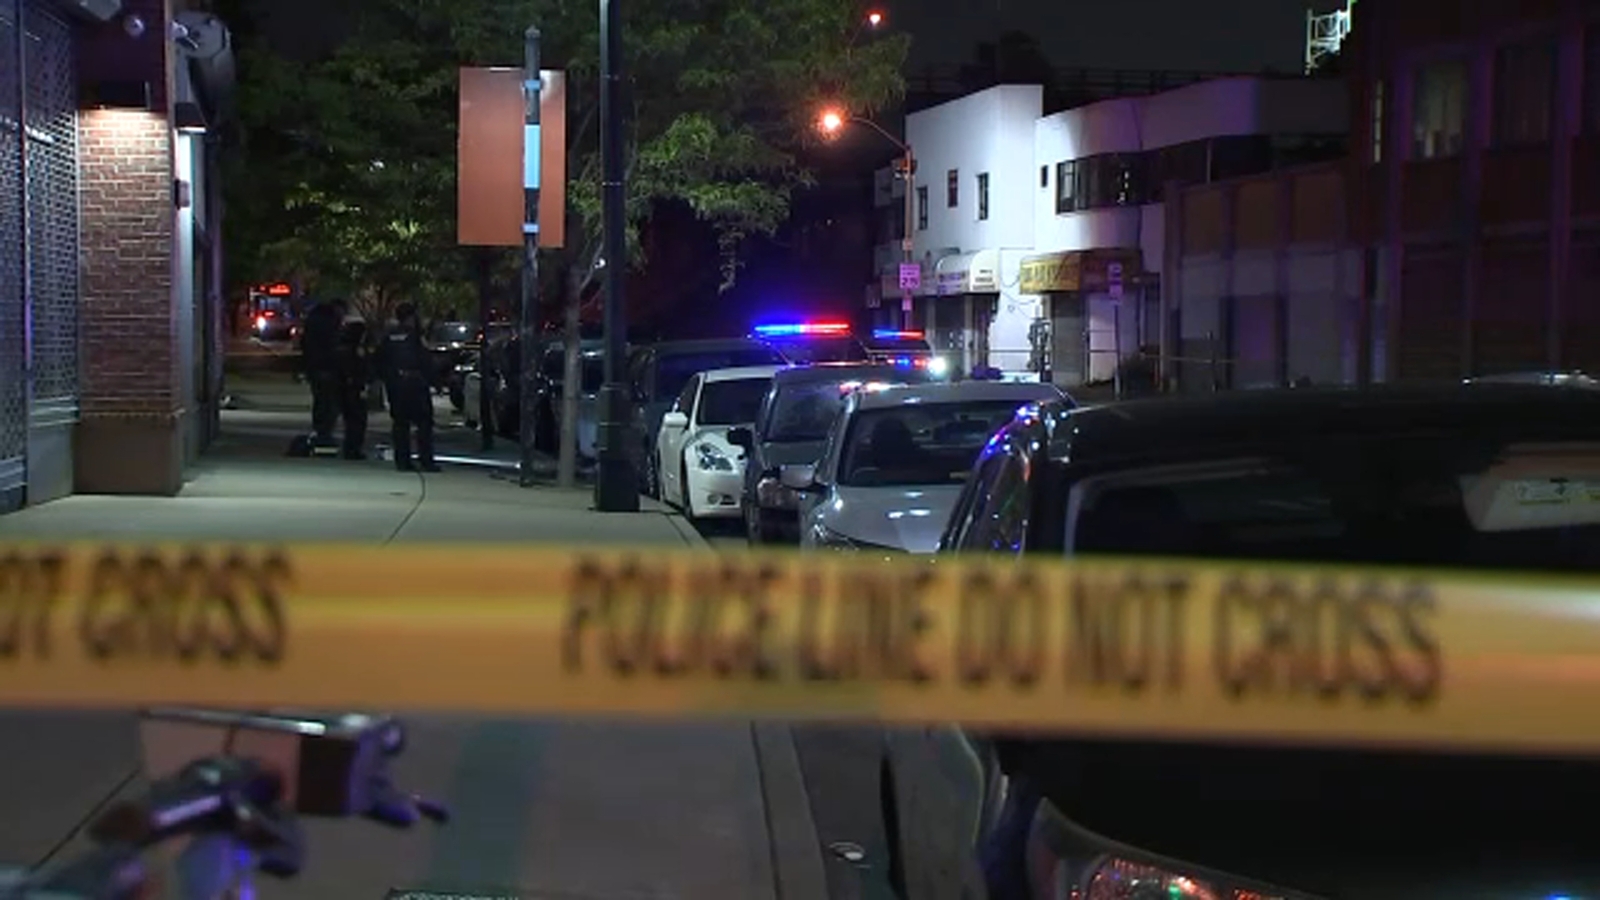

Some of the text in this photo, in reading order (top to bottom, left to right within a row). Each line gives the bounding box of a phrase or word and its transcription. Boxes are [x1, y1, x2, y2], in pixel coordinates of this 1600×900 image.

[79, 549, 293, 666] CROSS
[562, 557, 1442, 705] POLICE LINE DO NOT CROSS
